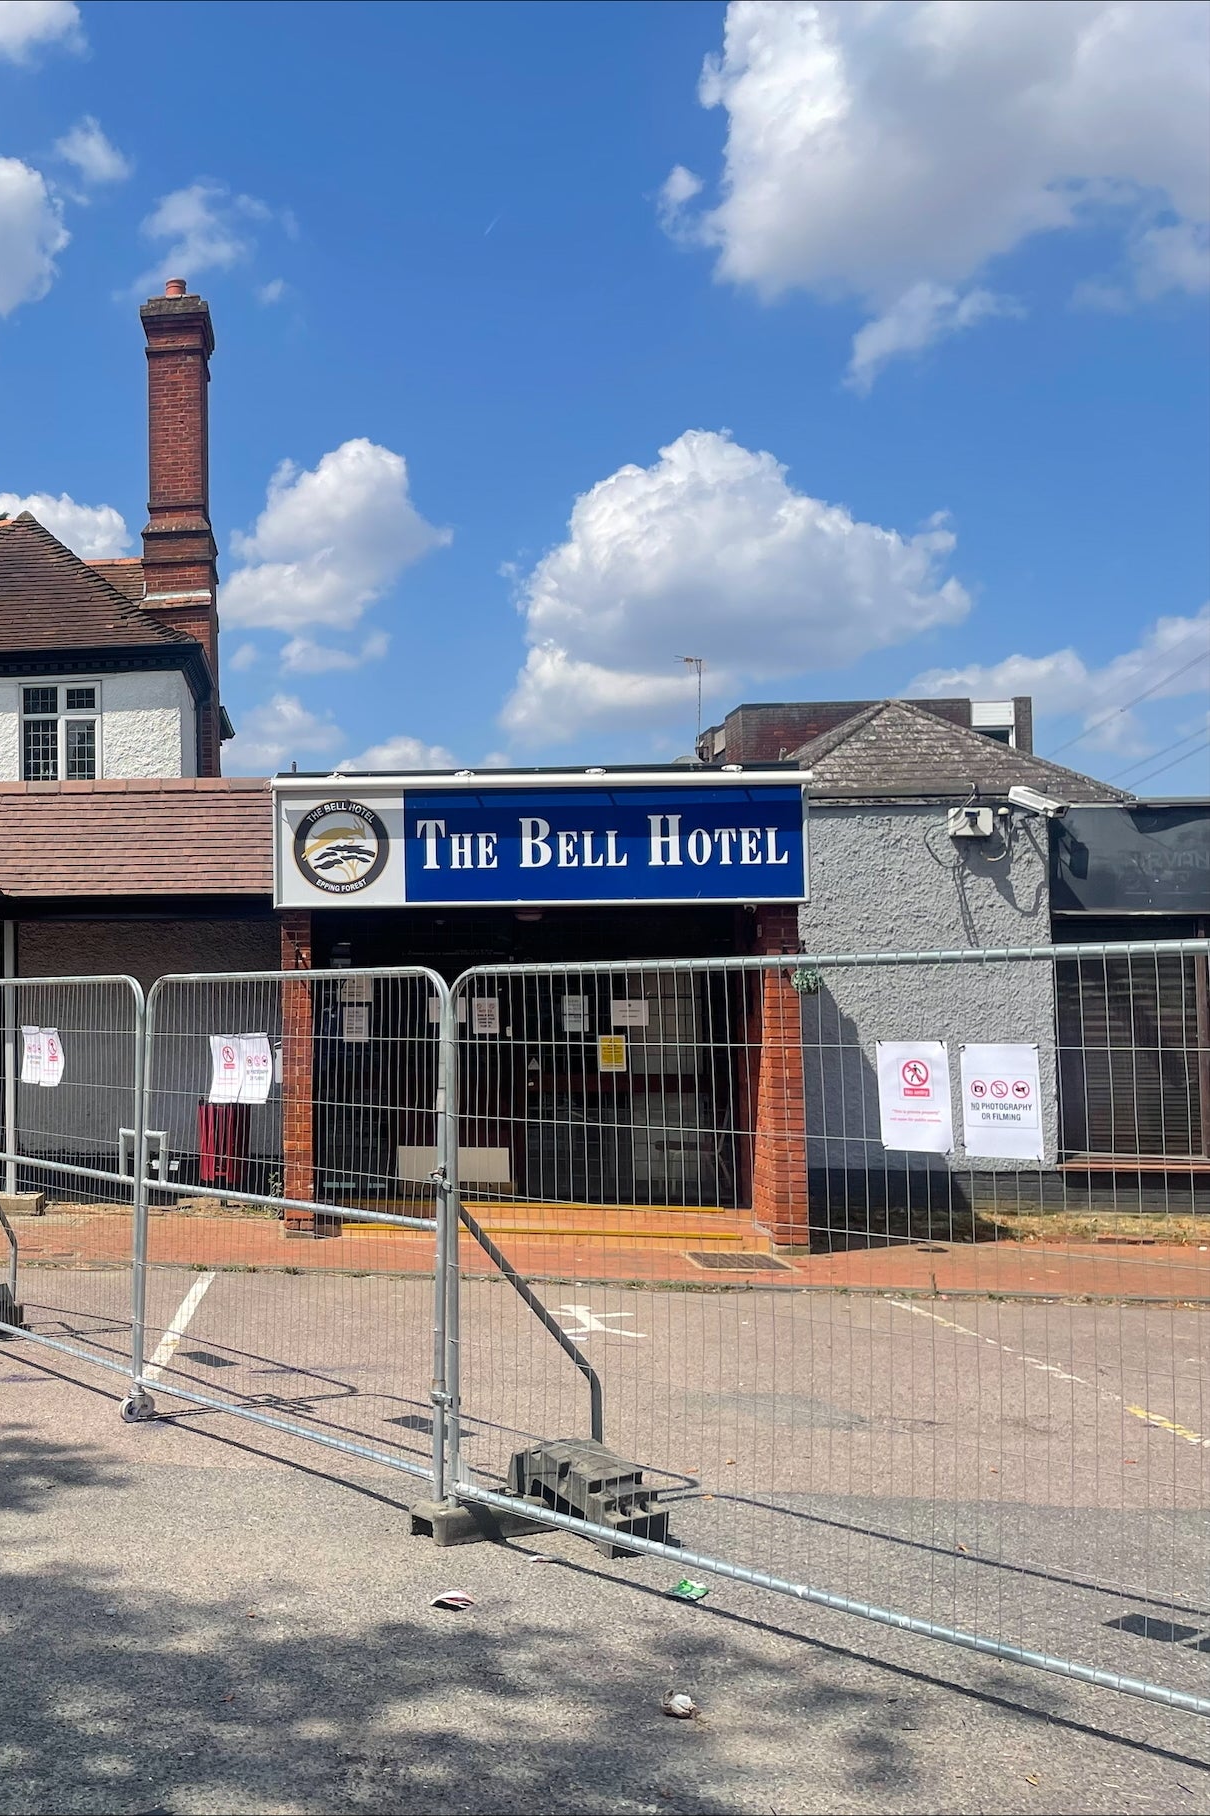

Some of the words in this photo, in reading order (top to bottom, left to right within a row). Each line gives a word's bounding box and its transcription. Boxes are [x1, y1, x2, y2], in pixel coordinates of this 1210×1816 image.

[306, 808, 324, 823] THE
[324, 802, 347, 812] BELL
[349, 803, 376, 823] HOTEL
[416, 819, 499, 870] THE
[519, 817, 628, 868] BELL
[647, 814, 789, 866] HOTEL
[316, 879, 340, 892] EPPING
[341, 878, 367, 892] FOREST
[970, 1102, 980, 1111] NO
[981, 1102, 1033, 1111] PHOTOGRAPHY
[981, 1112, 991, 1120] OR
[992, 1113, 1021, 1121] FILMING
